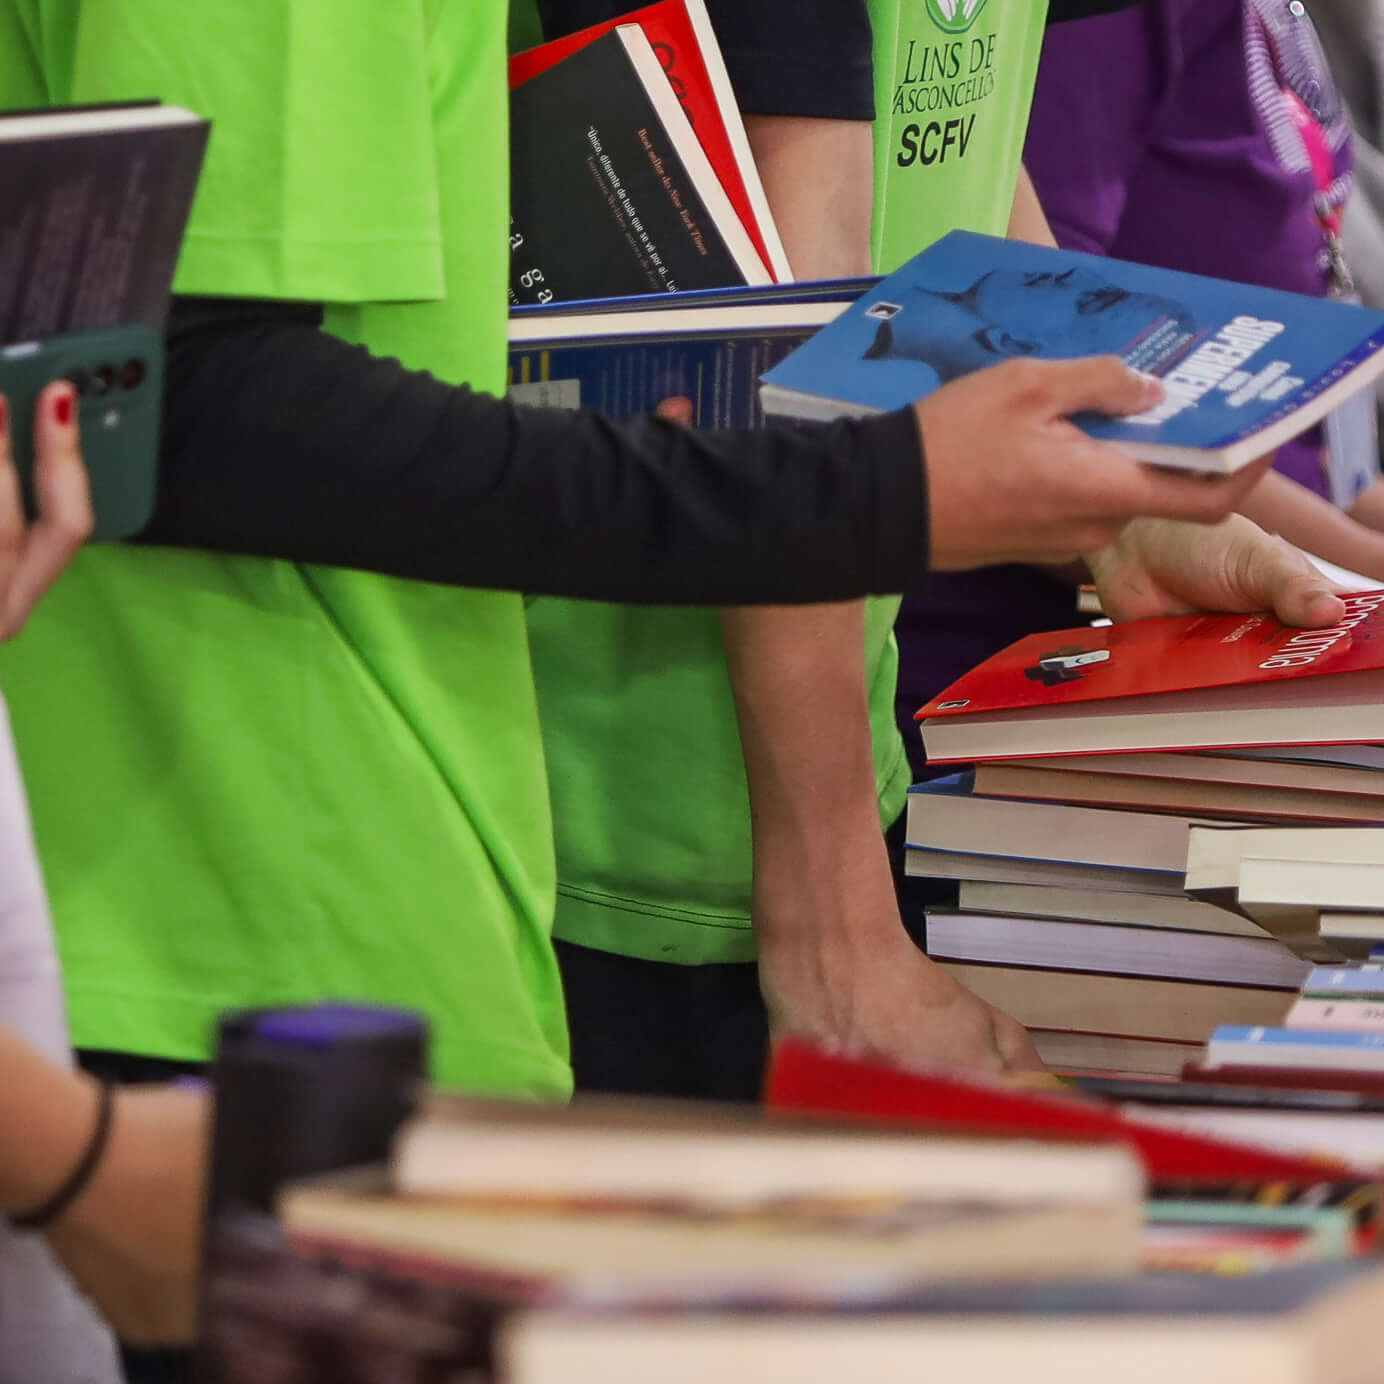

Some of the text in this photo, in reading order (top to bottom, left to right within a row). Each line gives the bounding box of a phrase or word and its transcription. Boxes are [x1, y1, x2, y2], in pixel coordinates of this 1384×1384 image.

[902, 33, 996, 84] LINS DE
[892, 71, 994, 115] ASCONCELLO
[897, 114, 976, 167] SCFV
[600, 154, 620, 187] diferente
[520, 268, 553, 304] ga
